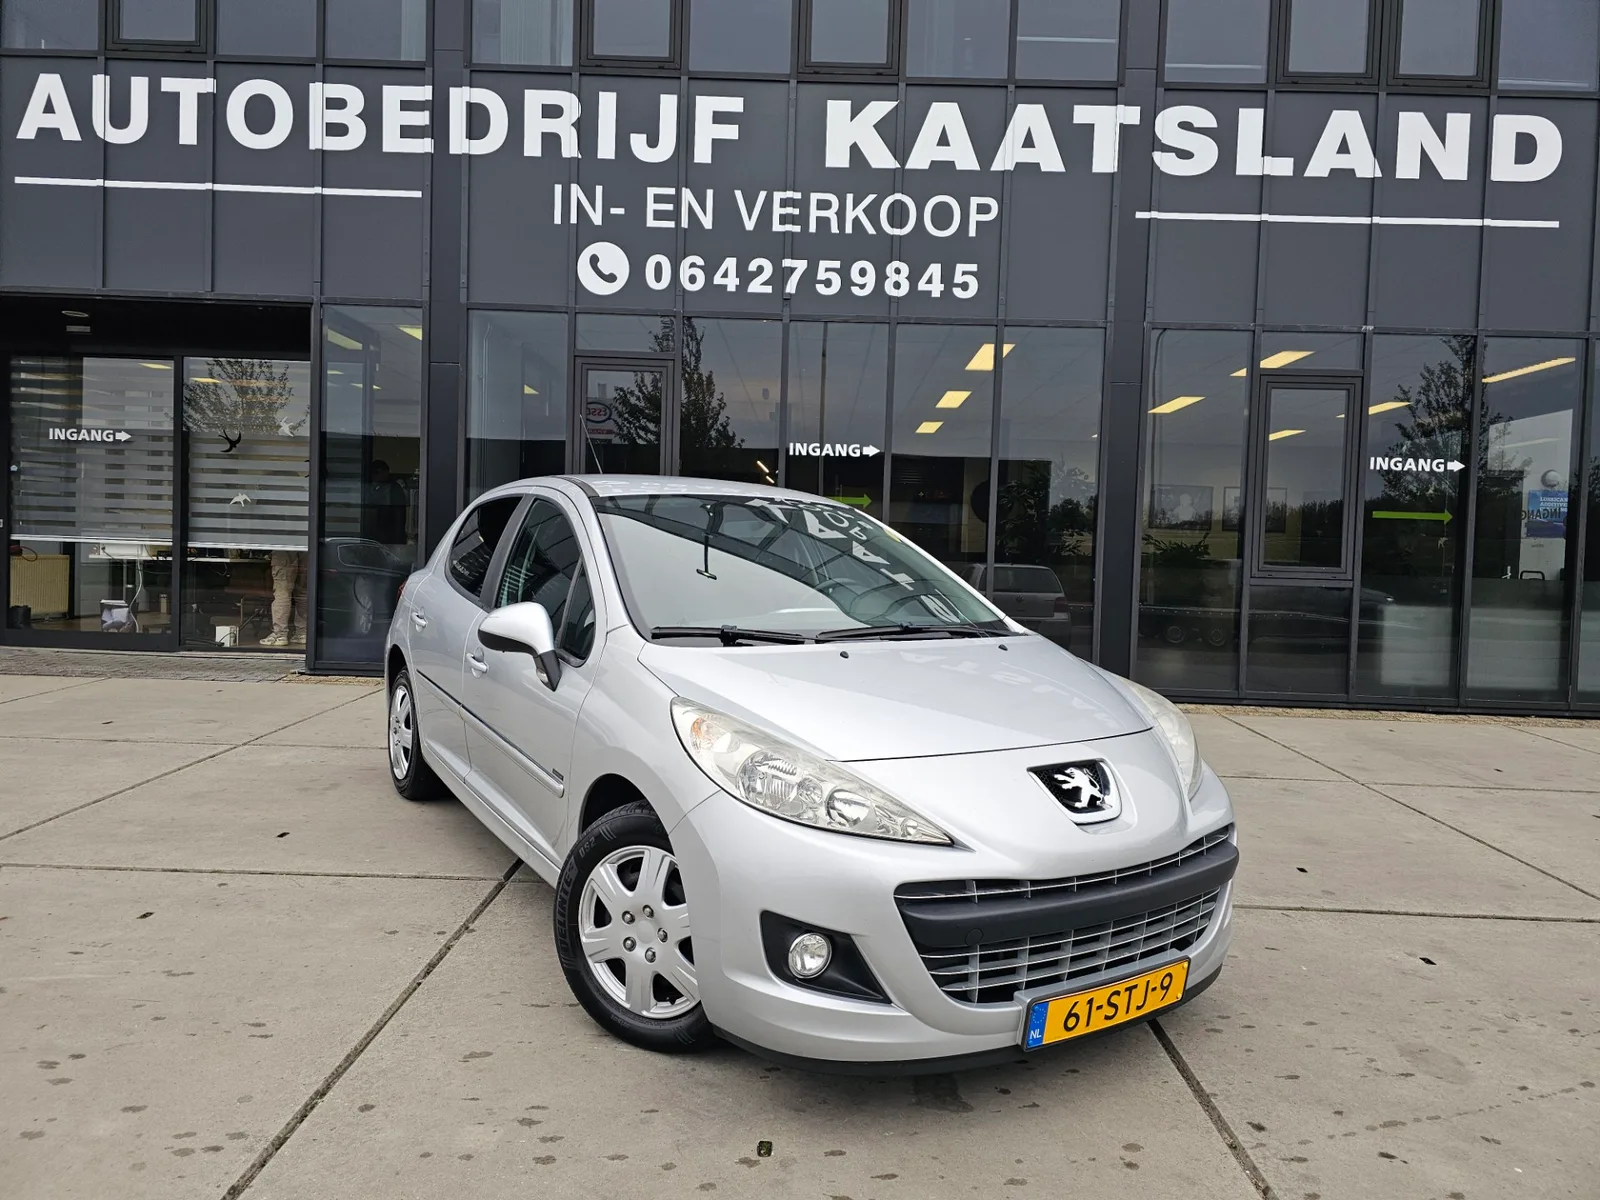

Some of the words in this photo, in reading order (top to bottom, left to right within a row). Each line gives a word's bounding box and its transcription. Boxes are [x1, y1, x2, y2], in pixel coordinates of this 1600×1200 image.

[16, 73, 745, 164] AUTOBEDRIJF
[825, 99, 1563, 182] KAATSLAND
[553, 183, 625, 226] IN-
[646, 186, 714, 230] EN
[733, 189, 999, 238] VERKOOP
[645, 253, 979, 299] 0642759845
[48, 427, 114, 442] INGANG
[789, 442, 861, 458] INGANG
[1369, 456, 1445, 473] INGANG
[1063, 972, 1173, 1032] 61-STJ-9
[1030, 1029, 1042, 1039] NL
